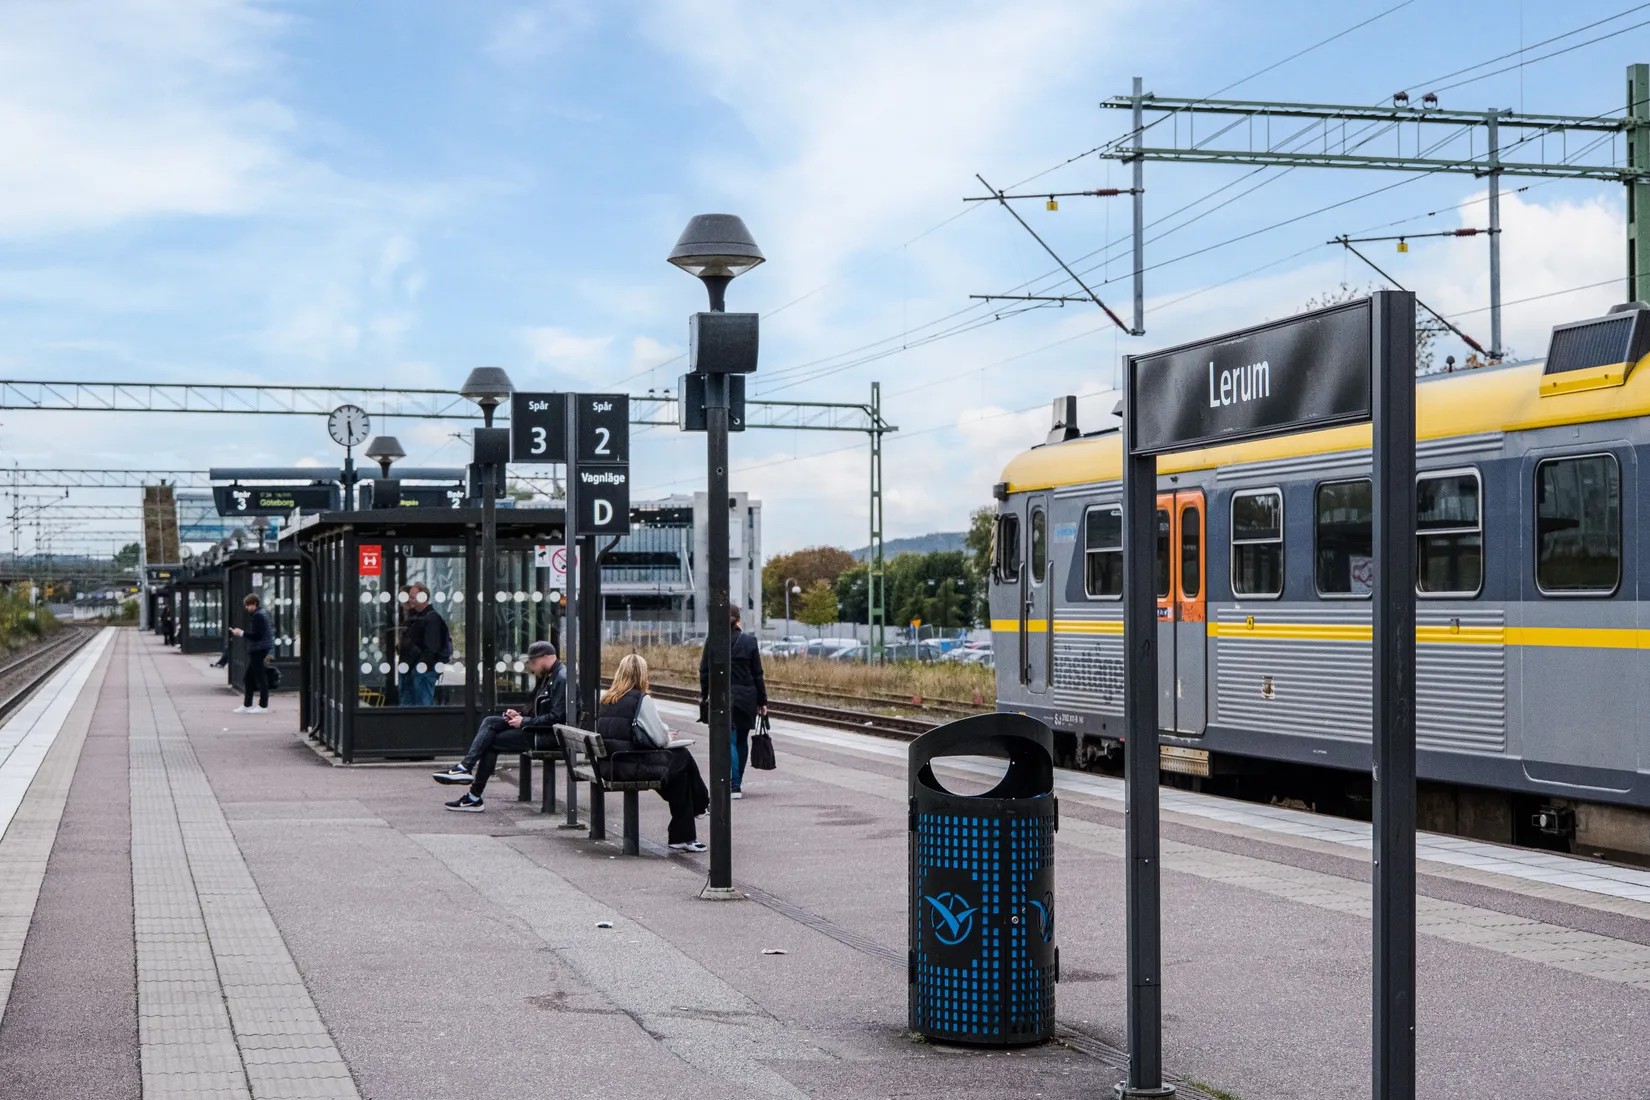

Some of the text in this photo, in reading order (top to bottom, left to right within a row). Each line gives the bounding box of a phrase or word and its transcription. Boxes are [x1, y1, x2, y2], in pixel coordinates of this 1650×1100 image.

[1209, 360, 1270, 408] Lerum
[528, 400, 549, 412] Spår
[592, 401, 613, 413] Spår
[530, 426, 547, 454] 3
[594, 427, 611, 455] 2
[581, 472, 626, 485] Vagnläge
[232, 490, 251, 498] Spår
[236, 498, 247, 511] 3
[259, 498, 295, 508] Göteborg
[451, 498, 461, 509] 2
[593, 499, 613, 526] D
